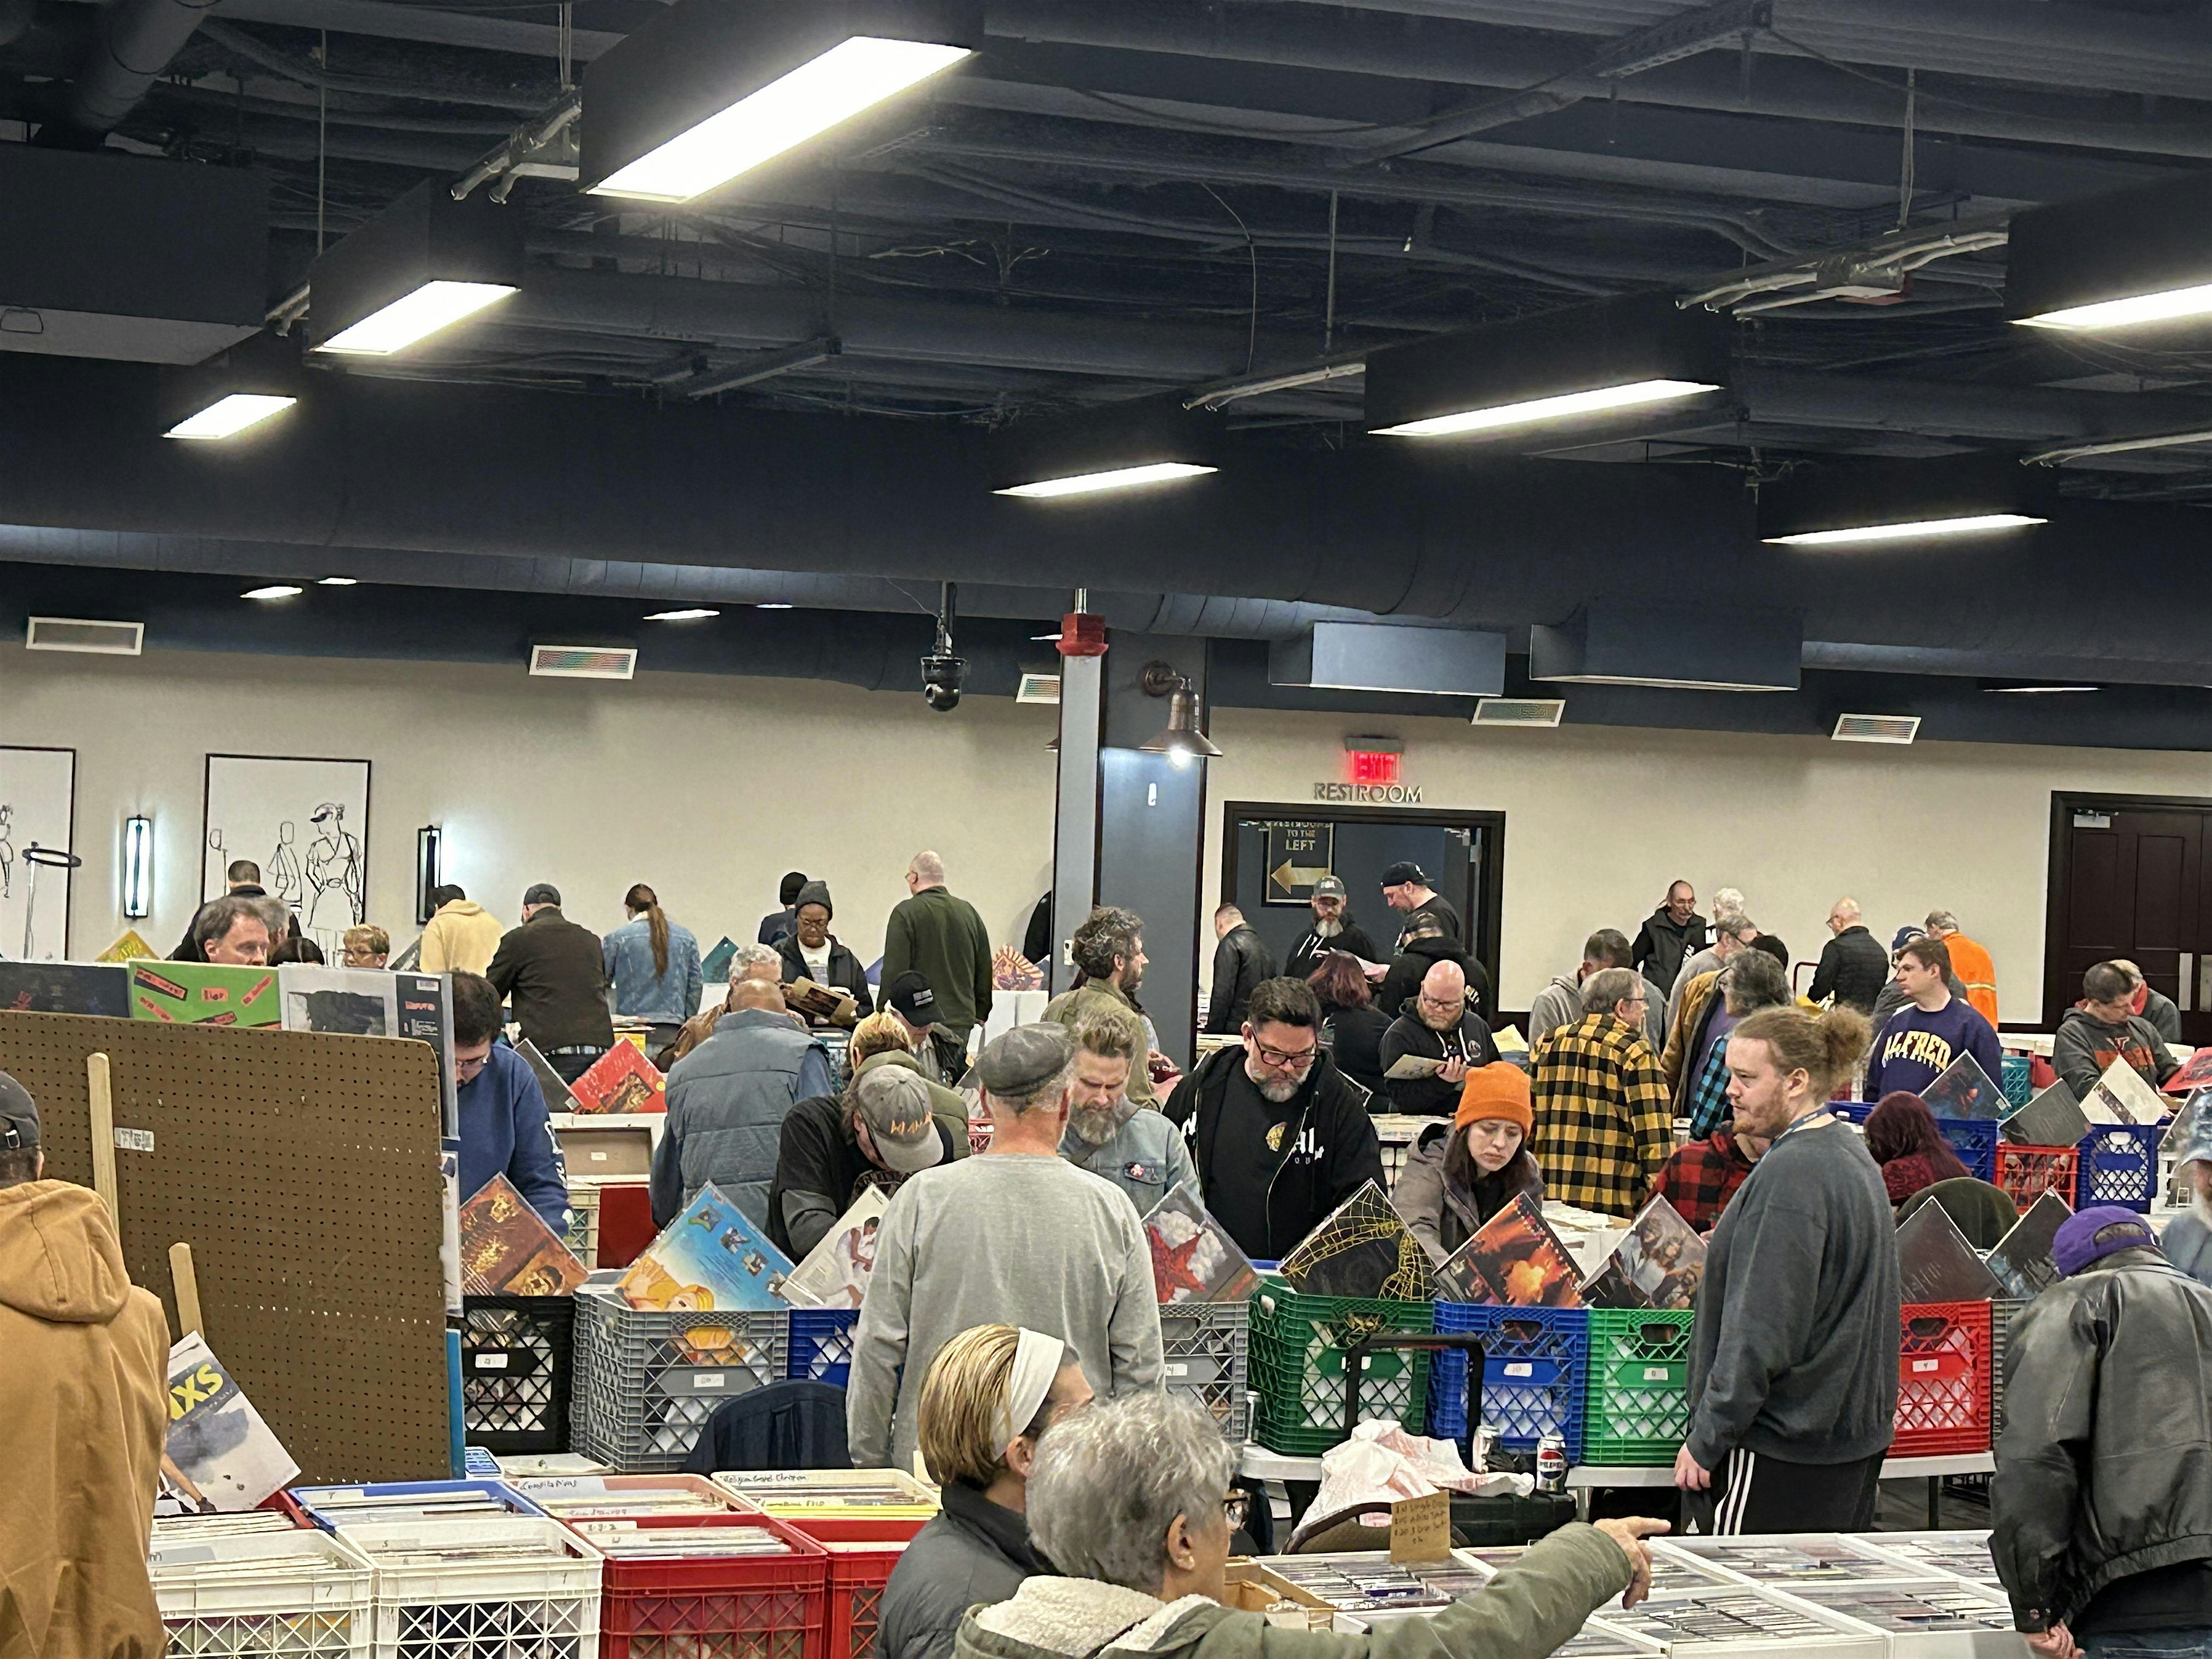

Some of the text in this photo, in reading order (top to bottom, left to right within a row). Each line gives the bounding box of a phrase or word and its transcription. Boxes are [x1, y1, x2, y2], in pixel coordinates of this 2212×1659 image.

[1357, 754, 1395, 780] EXIT
[1313, 782, 1423, 803] RESTROOM
[1285, 839, 1316, 851] LEFT
[1882, 1030, 1951, 1070] ALFRED
